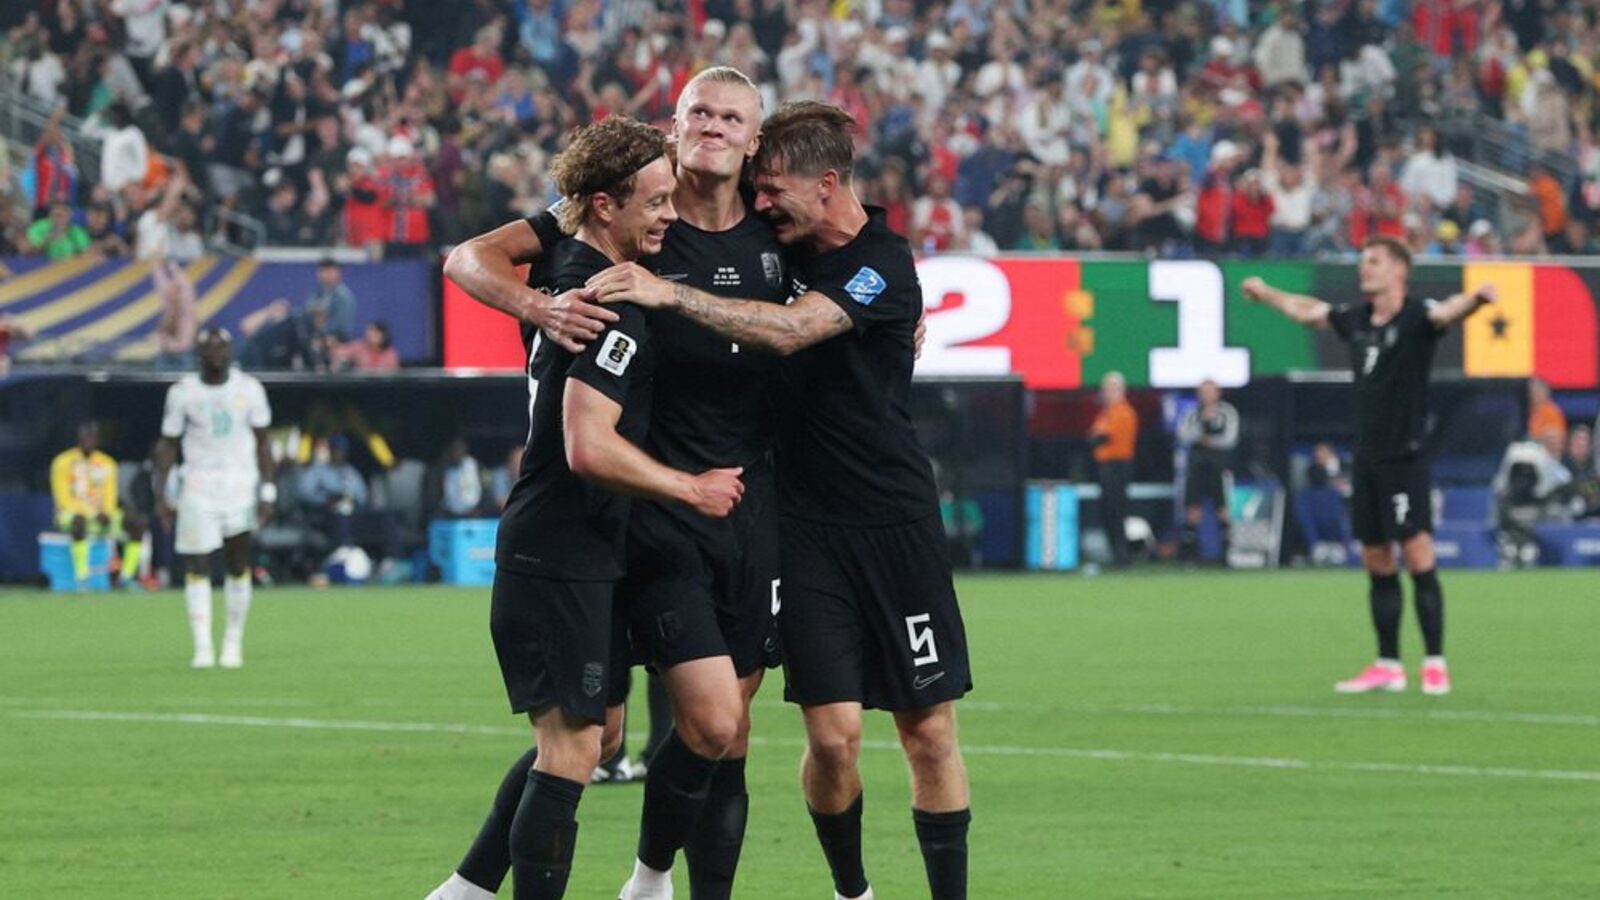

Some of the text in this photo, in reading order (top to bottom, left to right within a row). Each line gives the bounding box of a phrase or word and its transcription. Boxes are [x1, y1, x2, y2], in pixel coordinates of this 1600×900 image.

[913, 256, 1012, 374] 2
[1150, 260, 1250, 388] 1
[905, 613, 938, 666] 5
